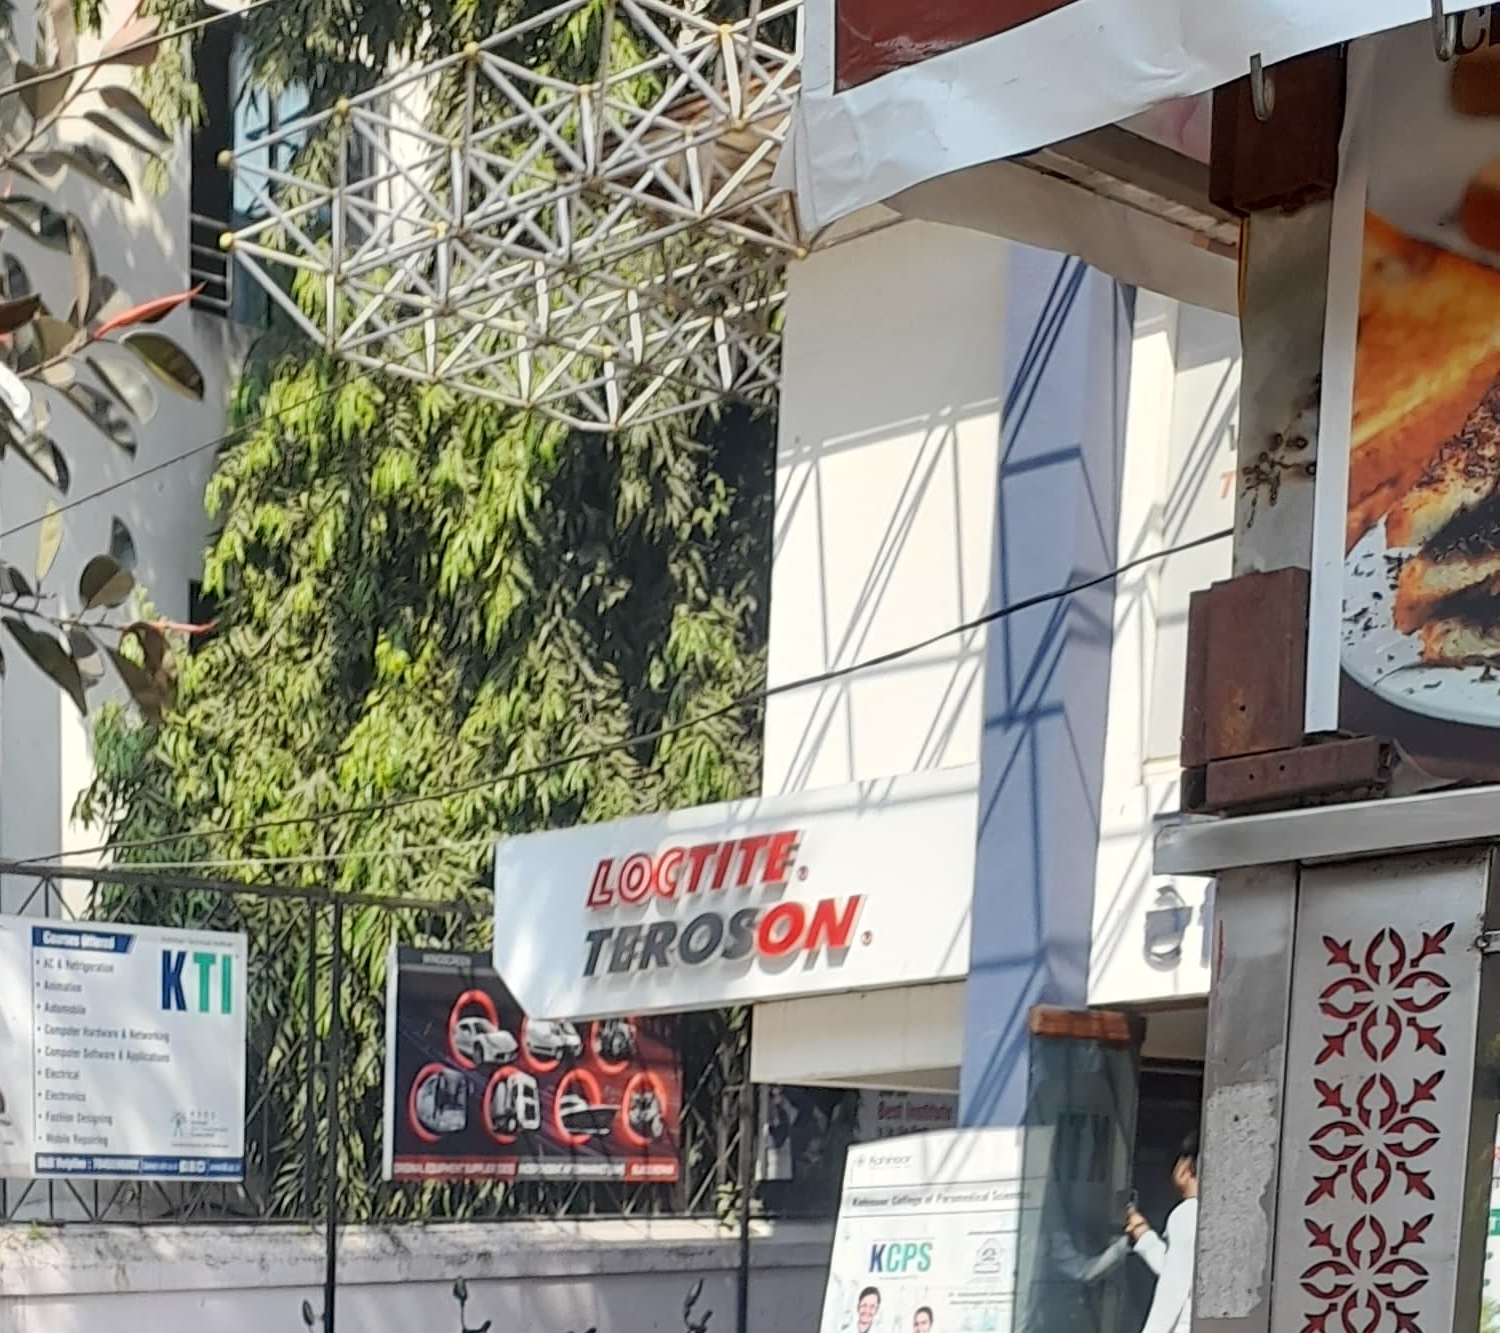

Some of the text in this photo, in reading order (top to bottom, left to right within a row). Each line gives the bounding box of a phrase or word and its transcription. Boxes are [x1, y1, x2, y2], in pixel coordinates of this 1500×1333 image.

[586, 829, 800, 908] LOCTITE
[582, 894, 862, 977] TEROSON
[162, 949, 232, 1014] KTI
[43, 1001, 87, 1015] Automobile
[44, 1024, 80, 1038] Computer
[83, 1026, 118, 1039] Hardware
[129, 1028, 171, 1044] Networking
[44, 1046, 81, 1060] Computer
[83, 1048, 116, 1060] Software
[126, 1050, 171, 1064] Applications
[44, 1067, 80, 1081] Electrical
[44, 1089, 87, 1103] Electronics
[76, 1112, 113, 1127] Designing
[73, 1133, 109, 1148] Repairing
[891, 1194, 923, 1207] College
[935, 1190, 989, 1203] Paramedical
[868, 1241, 934, 1274] KCPS
